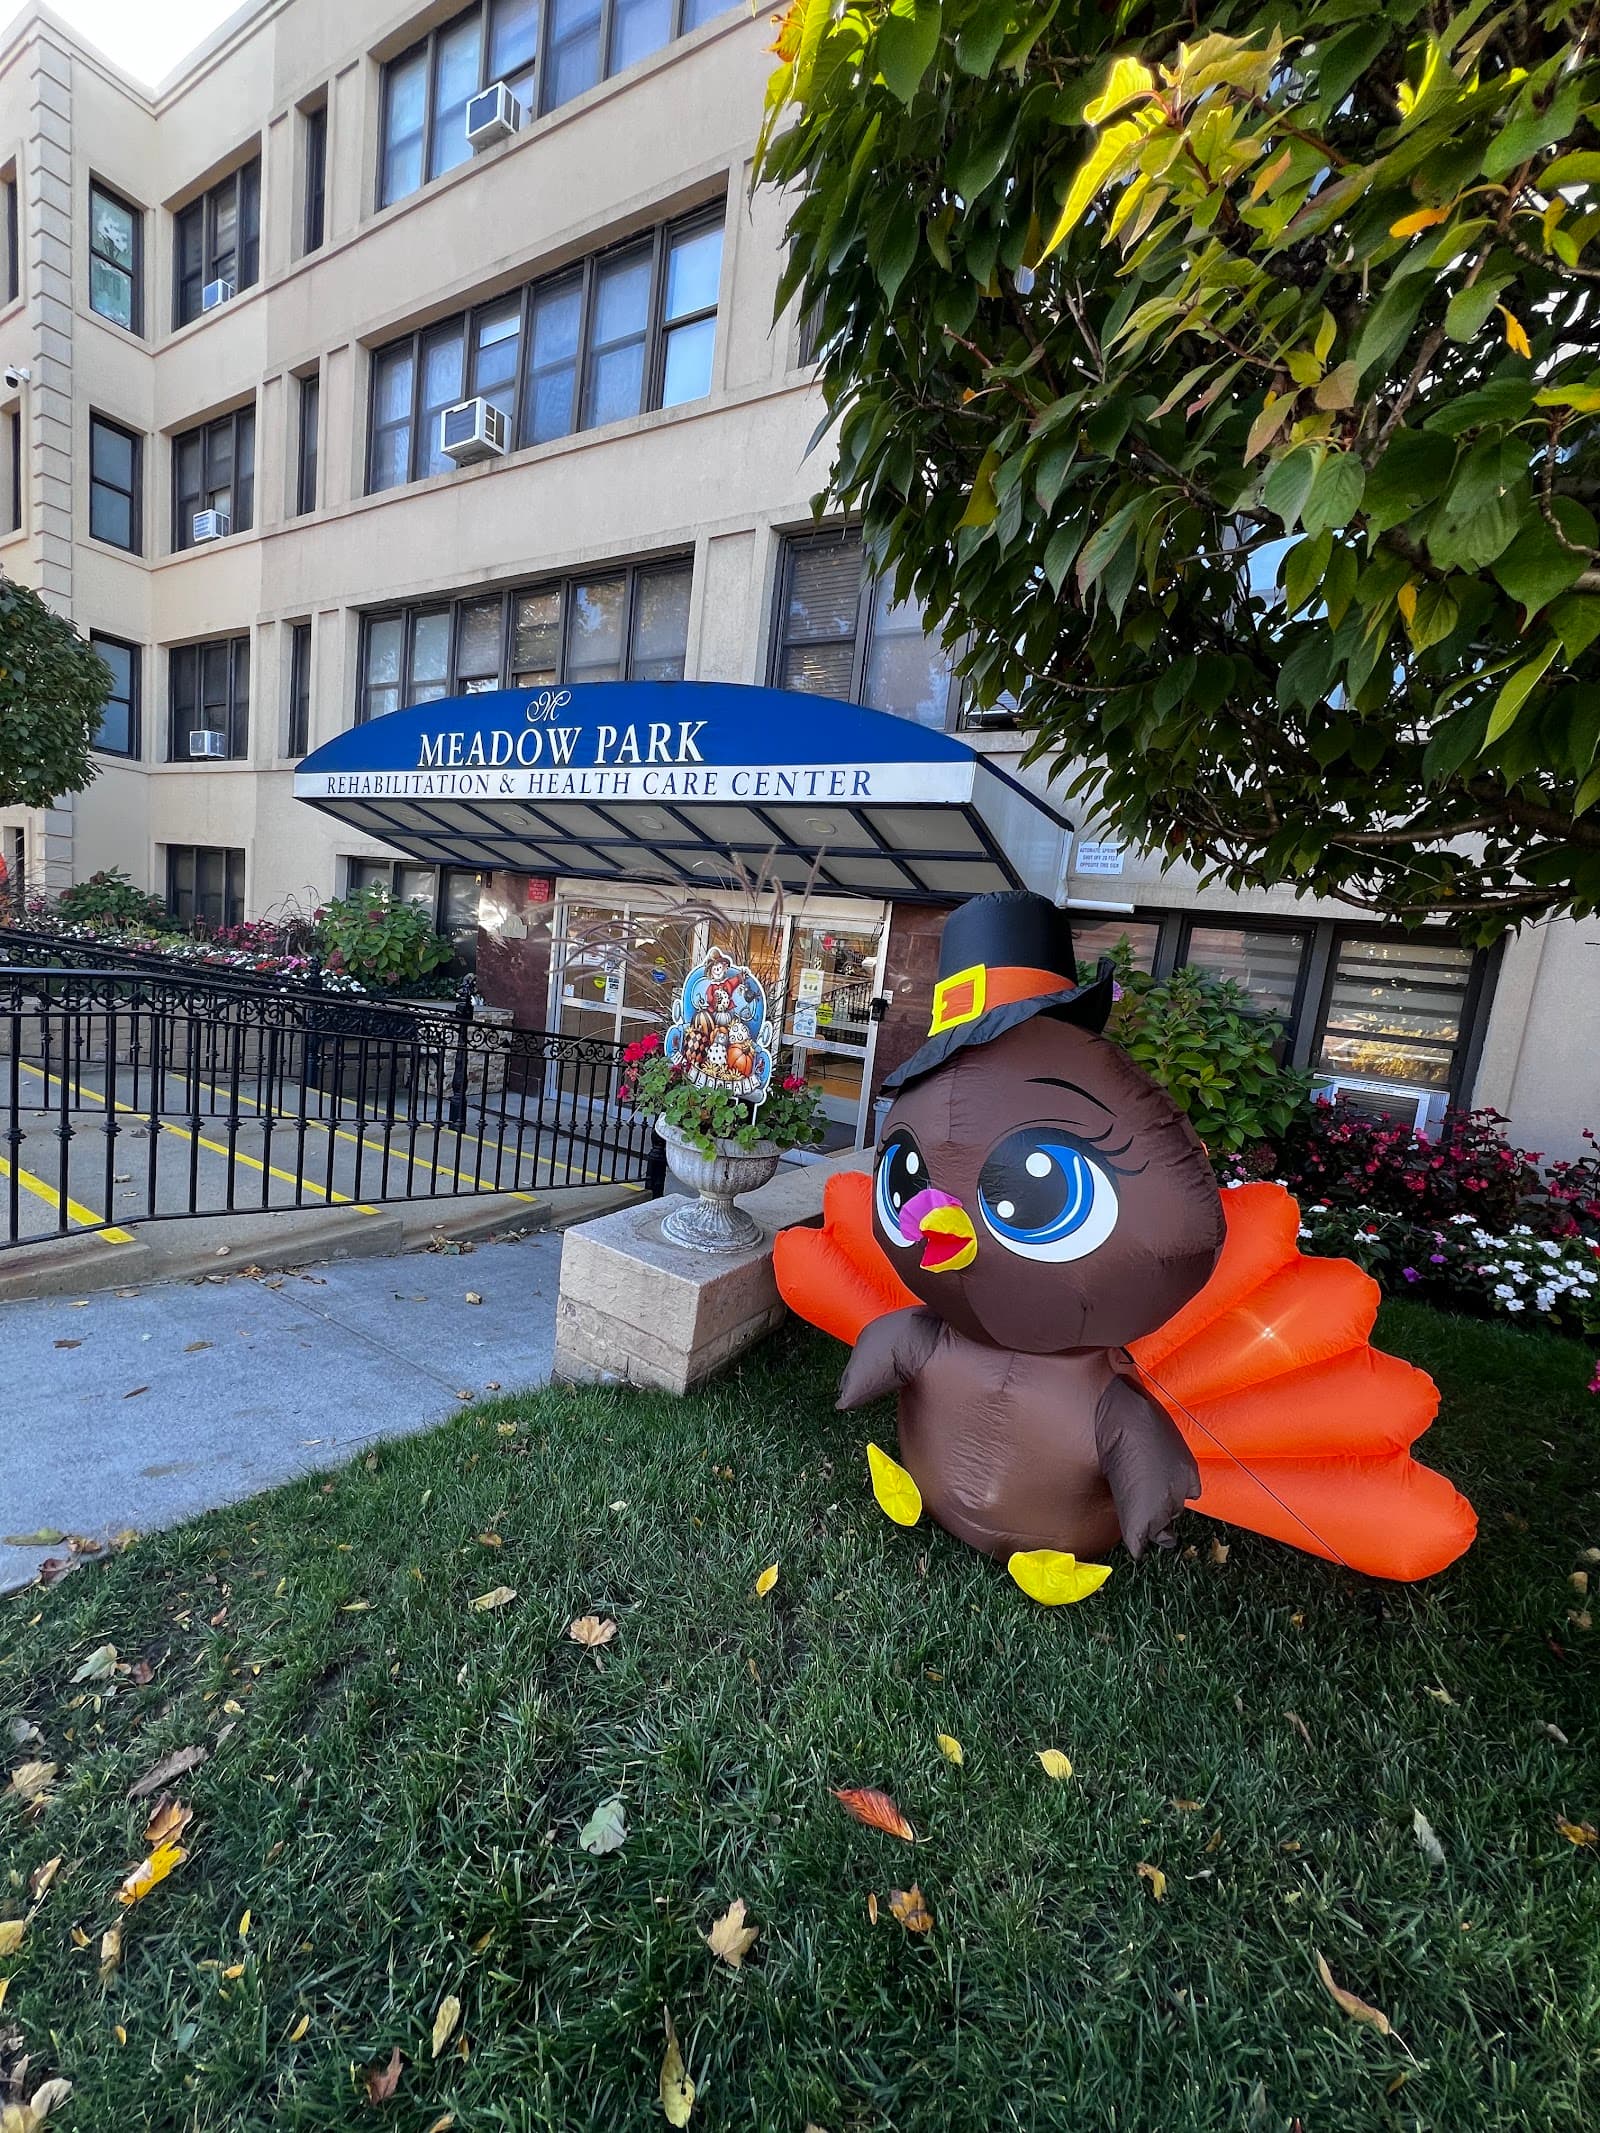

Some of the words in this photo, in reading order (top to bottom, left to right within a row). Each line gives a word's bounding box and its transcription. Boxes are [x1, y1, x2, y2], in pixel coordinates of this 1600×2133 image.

[417, 727, 582, 767] MEADOW
[593, 720, 708, 764] PARK
[327, 773, 490, 795] REHABILITATION
[499, 773, 515, 794] &
[527, 771, 630, 795] HEALTH
[642, 771, 718, 796] CARE
[731, 769, 872, 797] CENTER
